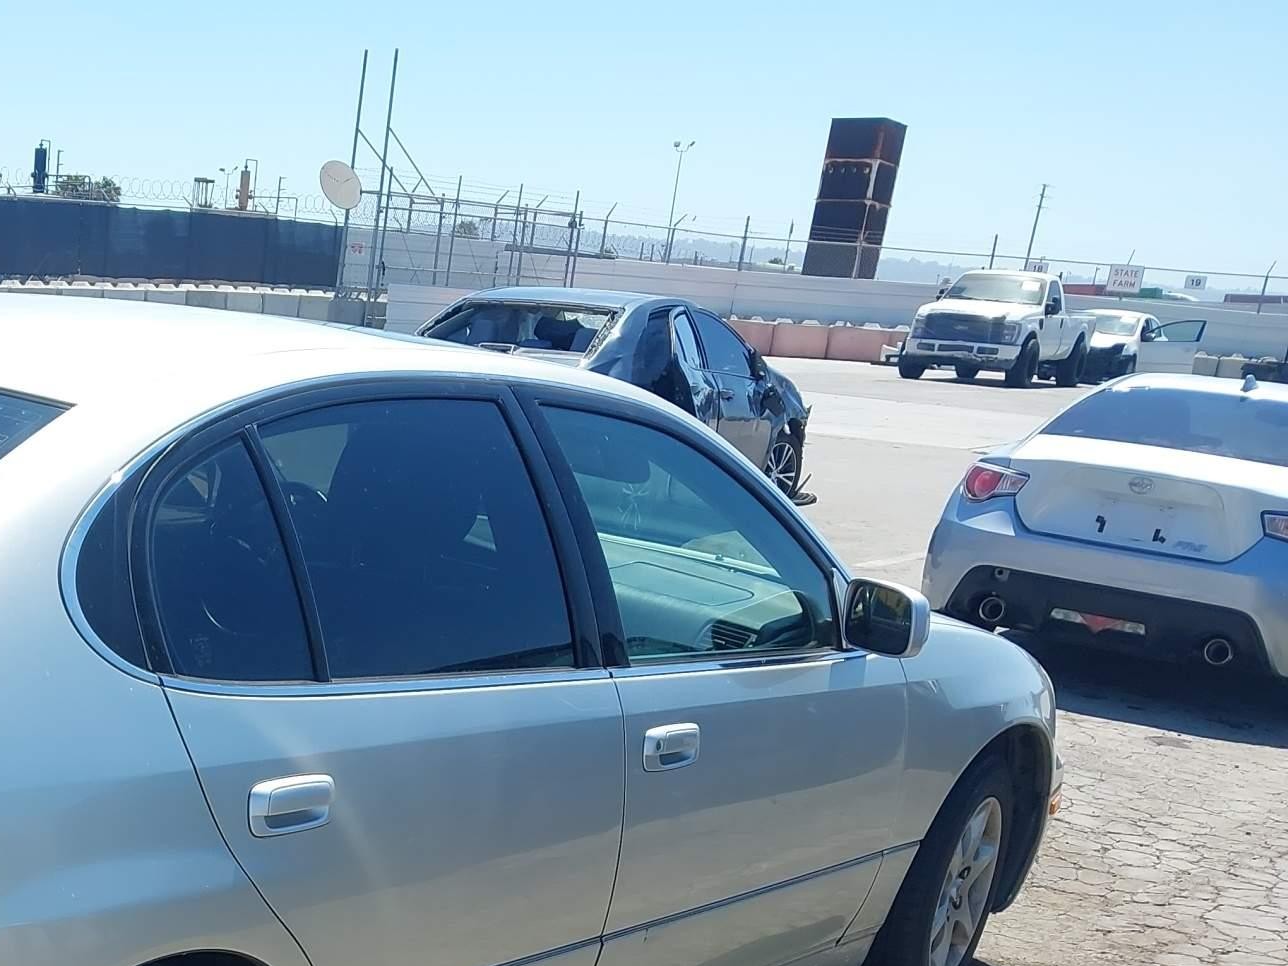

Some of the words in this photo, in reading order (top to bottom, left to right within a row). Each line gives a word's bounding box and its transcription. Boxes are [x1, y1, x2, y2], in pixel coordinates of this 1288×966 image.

[1113, 269, 1139, 278] STATE
[1112, 279, 1136, 288] FARM
[1191, 278, 1201, 287] 19
